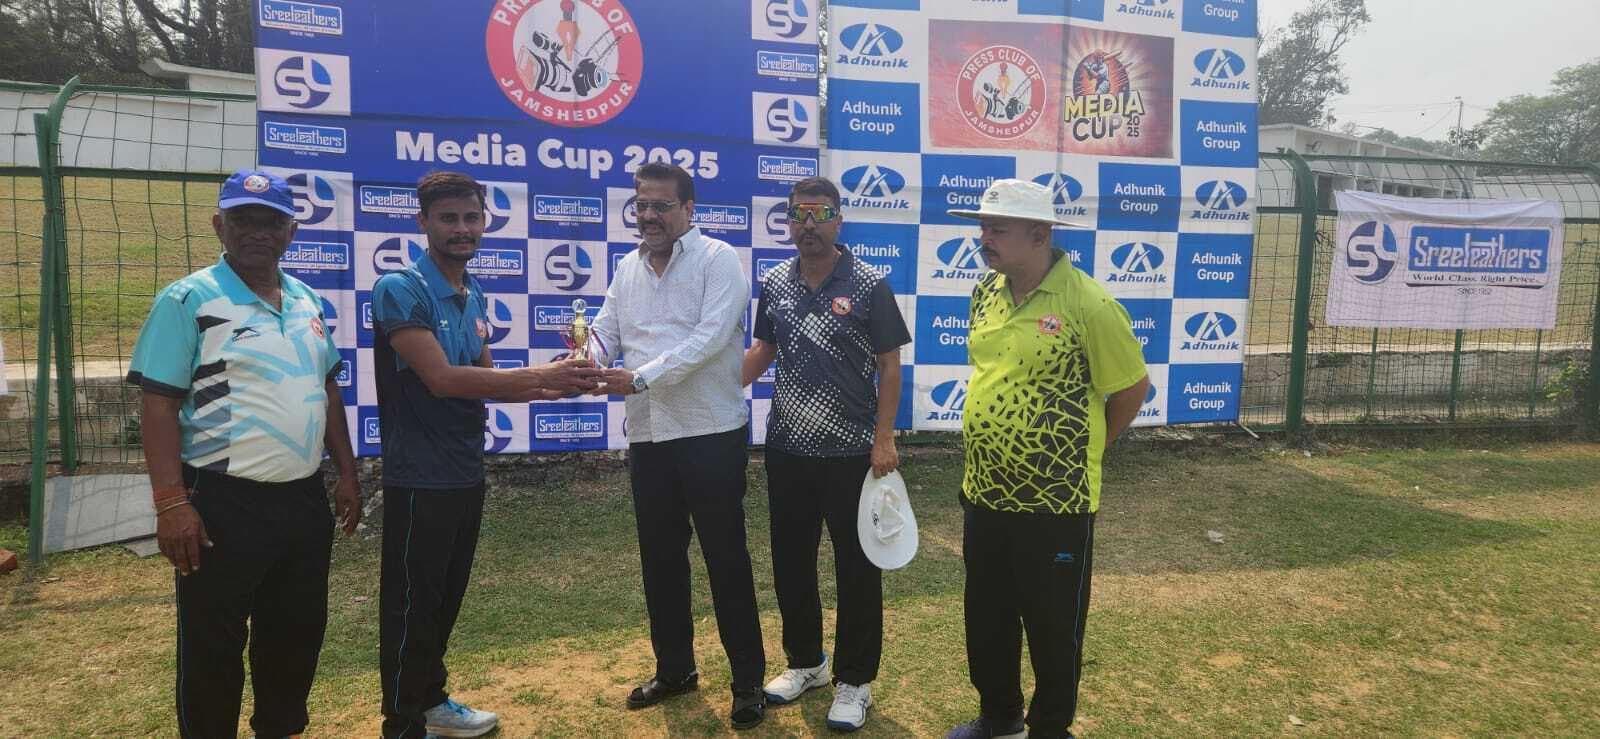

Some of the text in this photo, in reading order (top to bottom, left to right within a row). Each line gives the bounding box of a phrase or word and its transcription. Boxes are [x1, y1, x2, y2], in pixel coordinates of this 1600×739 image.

[264, 5, 338, 28] Sreeleathers
[1117, 4, 1175, 20] Adhunik
[1203, 4, 1238, 21] Group
[607, 9, 633, 34] OF
[760, 56, 815, 73] Sreeleathers
[836, 54, 908, 69] Adhunik
[962, 48, 1041, 81] PRESS CLUB OF
[1191, 77, 1250, 91] Adhunik
[501, 77, 633, 121] JAMSHEDPUR
[1064, 90, 1145, 123] MEDIA
[842, 100, 903, 116] Adhunik
[849, 119, 895, 136] Group
[964, 109, 1040, 136] JAMSHEDPUR
[1072, 114, 1123, 142] CUP
[1126, 115, 1140, 126] 20
[1196, 120, 1247, 134] Adhunik
[269, 127, 342, 147] Sreeleathers
[1126, 127, 1140, 137] 25
[1203, 136, 1241, 151] Group
[395, 131, 526, 167] Media
[537, 138, 613, 179] Cup
[760, 160, 815, 176] Sreeleathers
[1114, 183, 1166, 197] Adhunik
[364, 191, 420, 207] Sreeleathe
[840, 197, 910, 210] Adhunik
[946, 192, 981, 206] Grou
[538, 200, 600, 216] Sreeleathers
[1056, 206, 1087, 216] unik
[1120, 200, 1159, 214] Group
[1190, 209, 1249, 222] Adhunik
[280, 246, 345, 264] eeleathers
[1414, 232, 1543, 269] Sreeleathers
[466, 252, 520, 269] eeleathers
[1191, 252, 1242, 266] Adhunik
[1105, 272, 1167, 284] Adhunik
[1197, 268, 1235, 283] Group
[932, 315, 970, 329] Adhu
[1131, 317, 1156, 330] unik
[939, 332, 968, 346] Gro
[1180, 341, 1240, 351] Adhunik
[1183, 382, 1232, 394] Adhunik
[1189, 398, 1225, 411] Group
[539, 418, 600, 433] Sreeleathers
